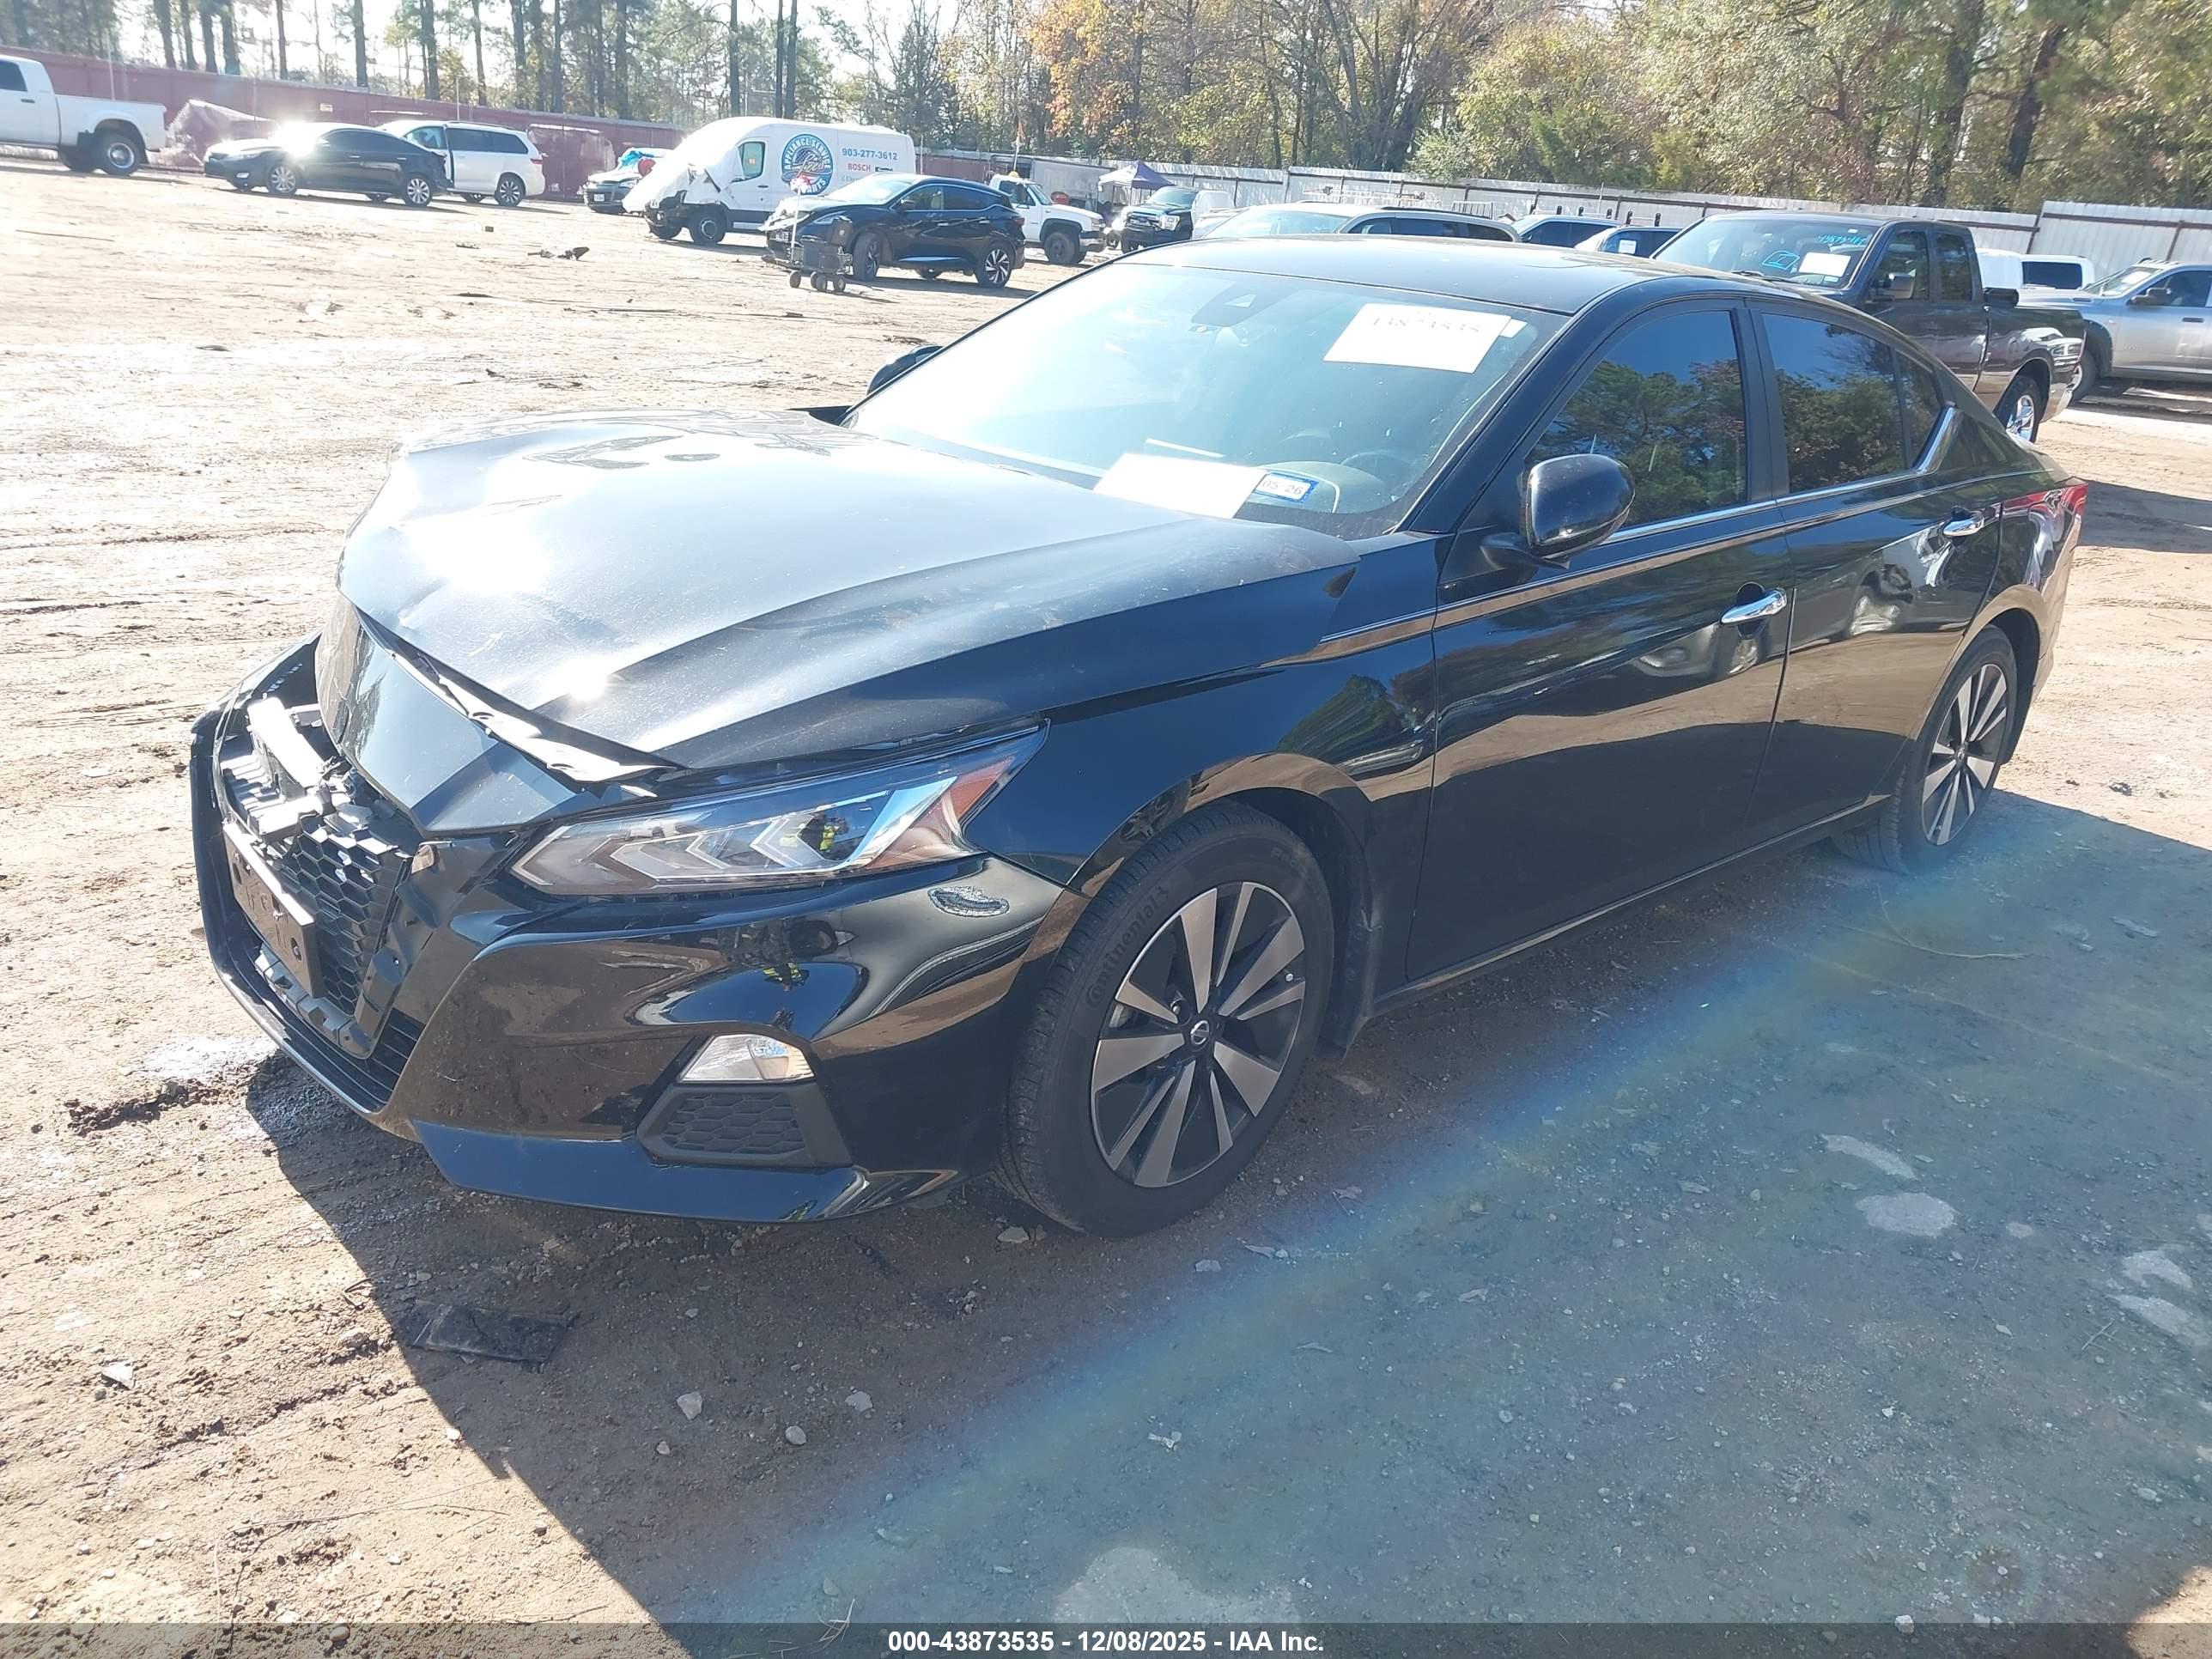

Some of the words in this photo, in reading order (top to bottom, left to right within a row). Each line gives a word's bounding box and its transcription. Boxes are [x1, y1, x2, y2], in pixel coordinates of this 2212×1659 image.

[784, 137, 811, 170] APPLIANCE
[811, 139, 831, 169] SERVICE
[842, 148, 898, 161] 903-277-3612
[848, 163, 872, 172] BOSCH
